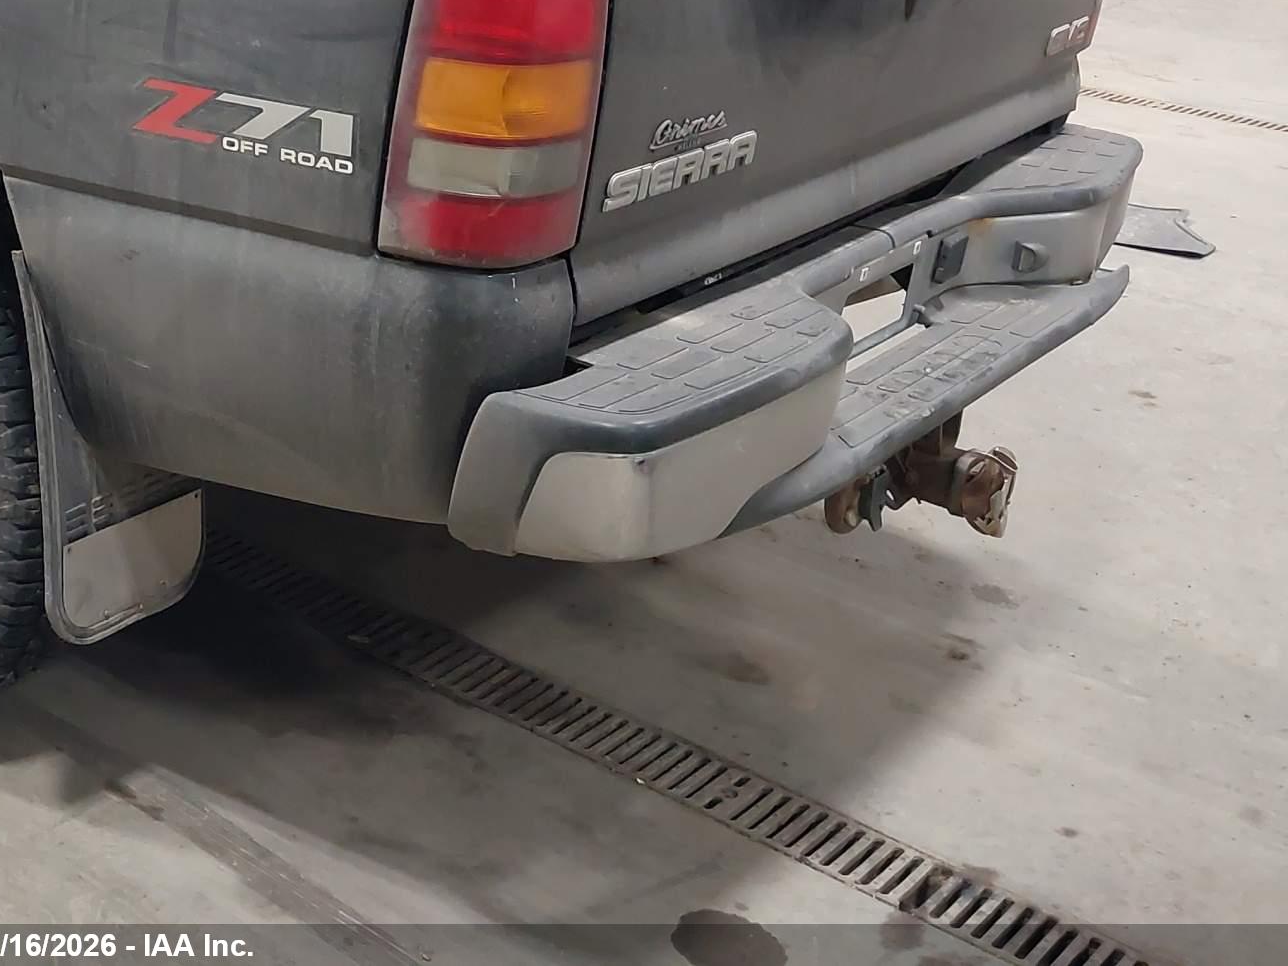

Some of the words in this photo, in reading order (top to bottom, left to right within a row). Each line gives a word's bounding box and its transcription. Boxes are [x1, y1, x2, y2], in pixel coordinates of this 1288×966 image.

[133, 78, 355, 157] Z71
[222, 136, 269, 157] OFF
[280, 148, 354, 175] ROAD
[602, 129, 759, 214] SIERRA
